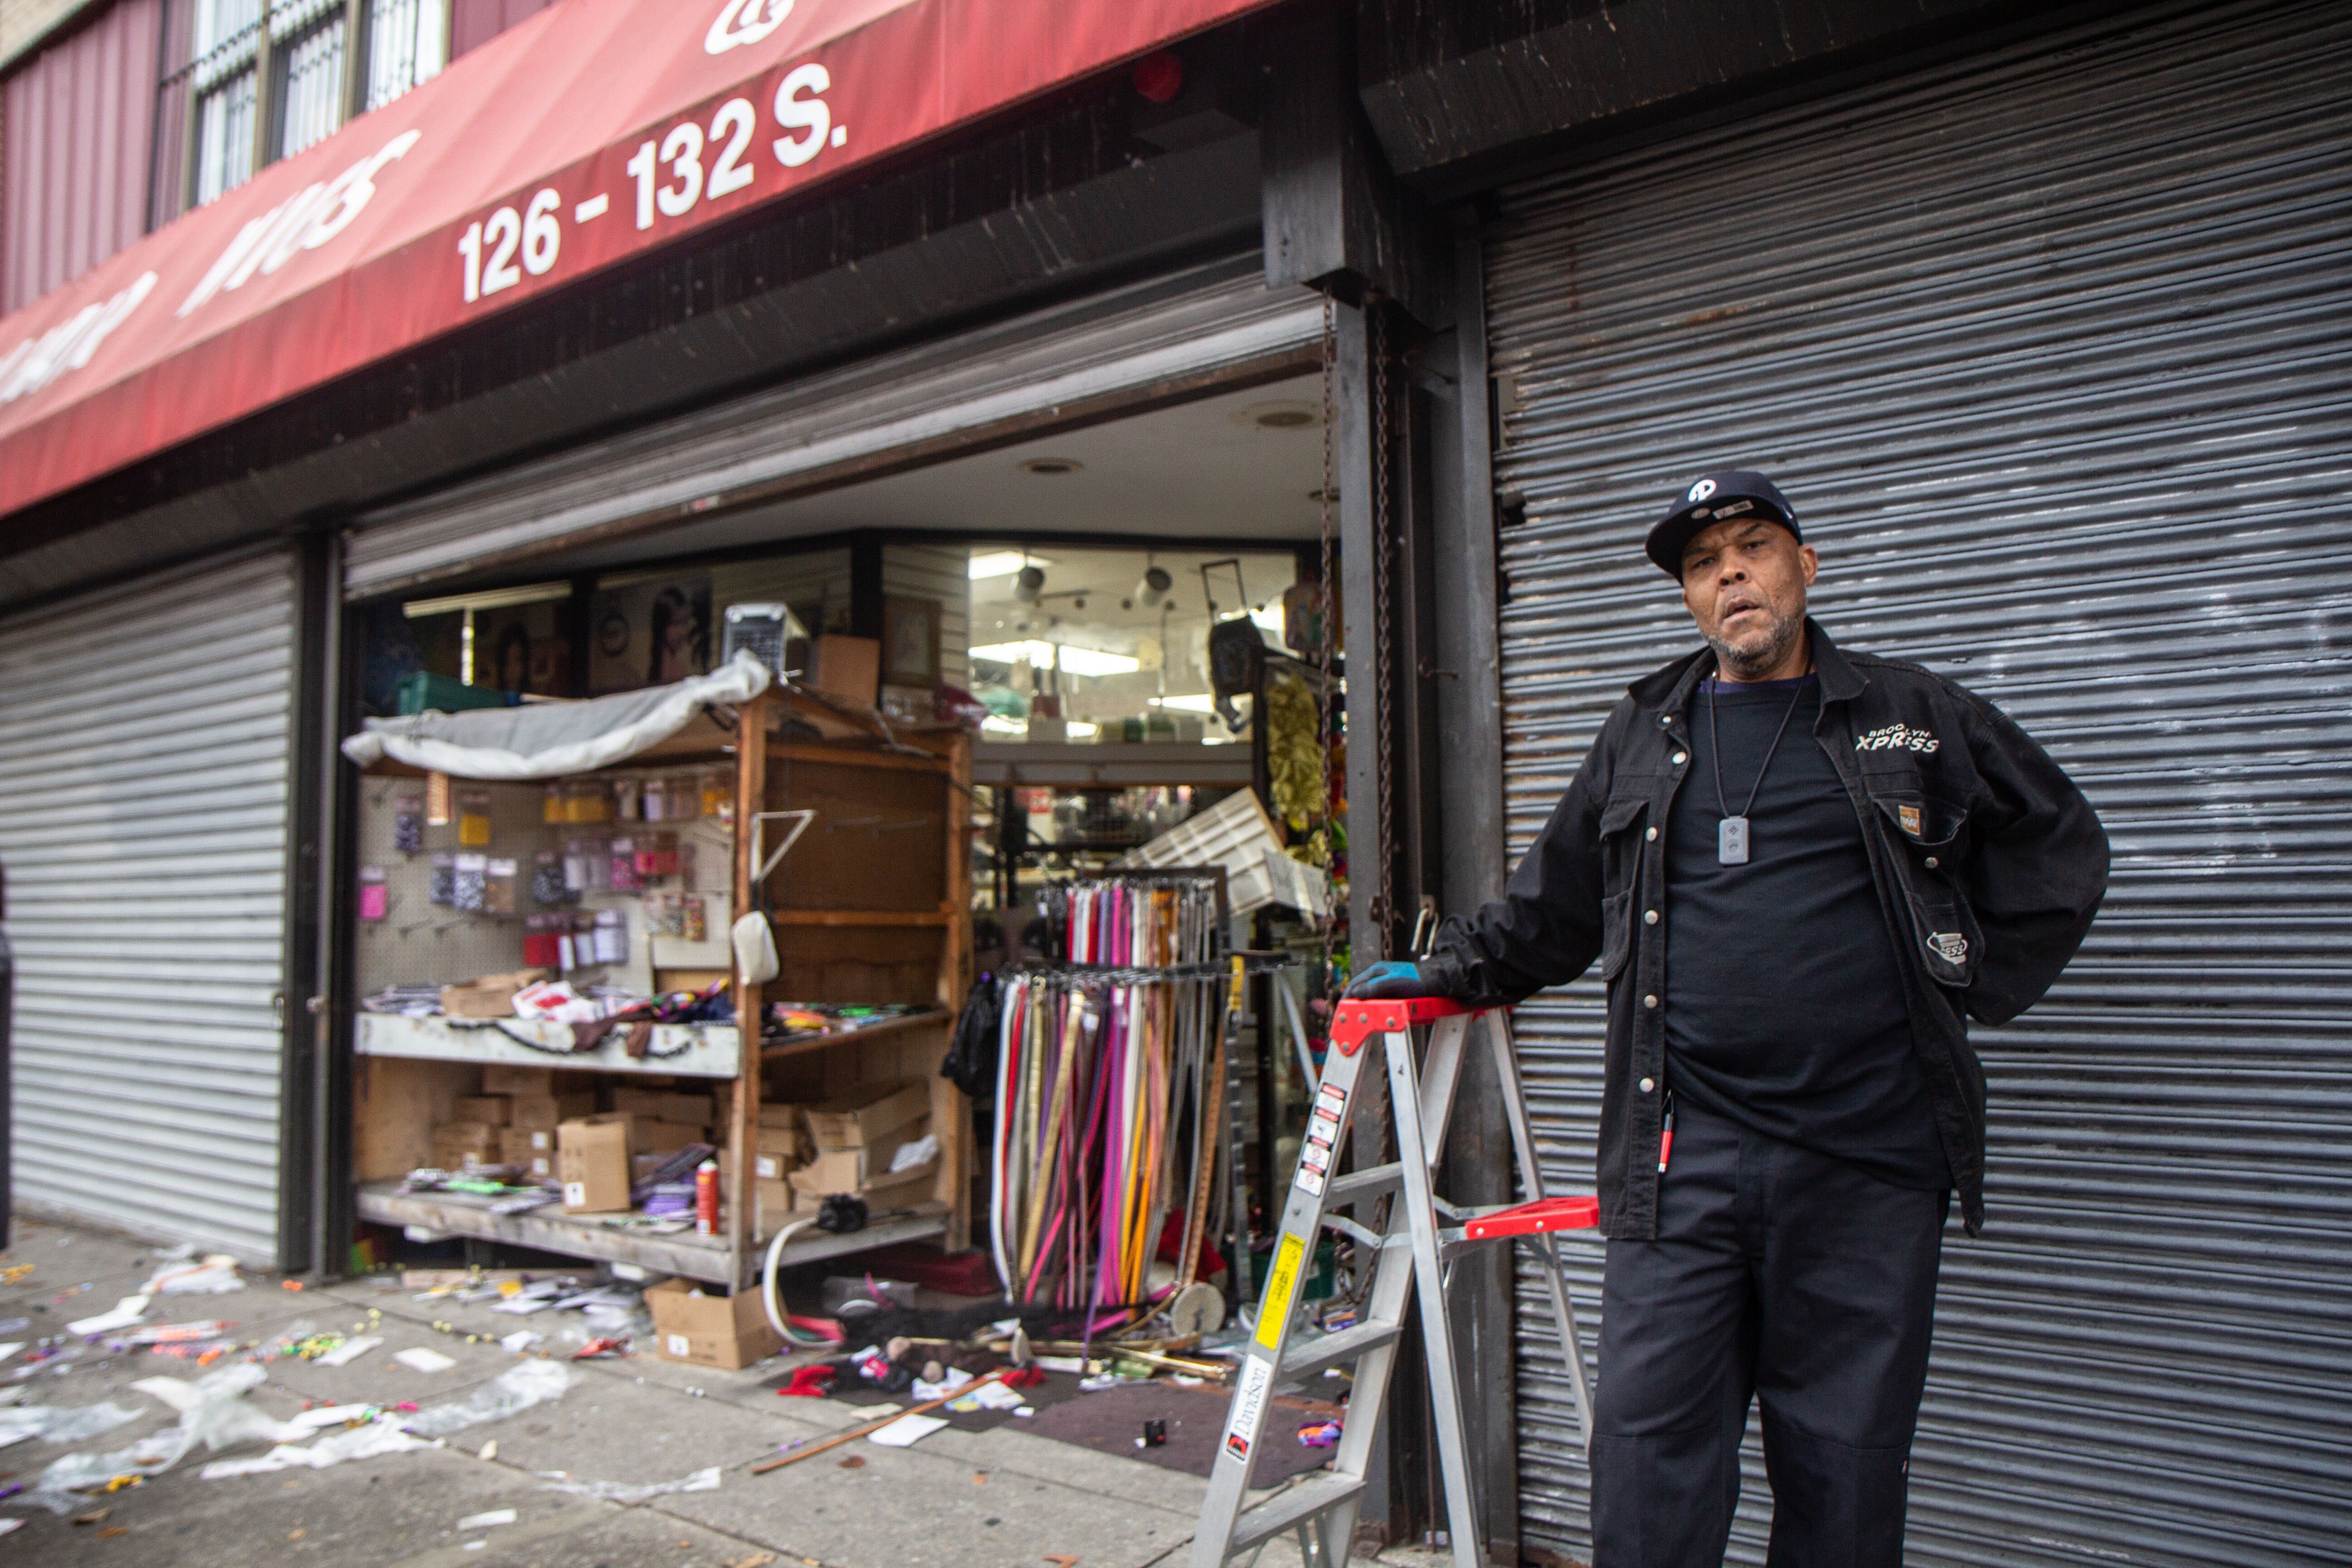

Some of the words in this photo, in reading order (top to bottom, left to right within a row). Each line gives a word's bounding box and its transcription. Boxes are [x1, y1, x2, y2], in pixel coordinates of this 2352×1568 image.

[458, 187, 561, 303] 126
[627, 98, 757, 230] 132
[772, 63, 847, 167] S.
[1235, 1367, 1267, 1436] Davidson
